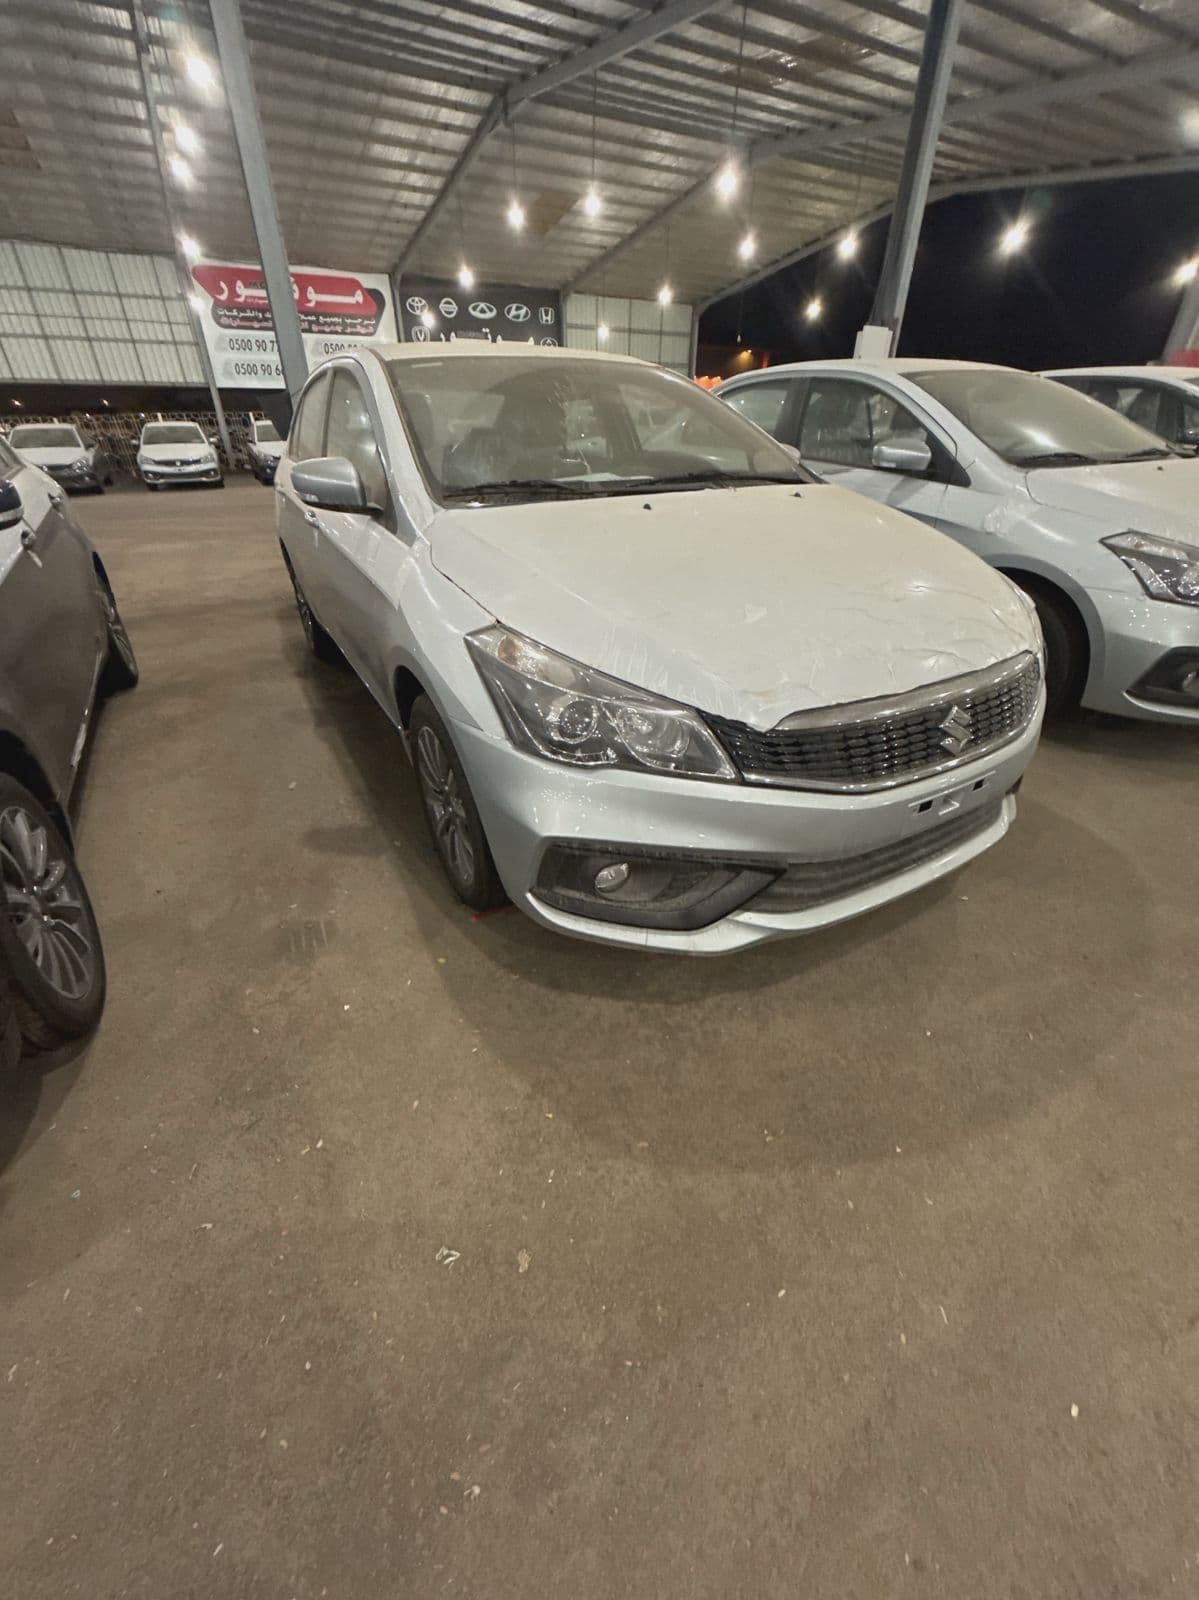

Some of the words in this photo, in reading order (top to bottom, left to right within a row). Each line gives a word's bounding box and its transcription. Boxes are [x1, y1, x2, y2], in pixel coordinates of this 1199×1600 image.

[229, 338, 252, 352] 0500
[255, 339, 267, 352] 90
[234, 363, 258, 376] 0500
[261, 363, 272, 376] 90
[275, 364, 283, 376] 6
